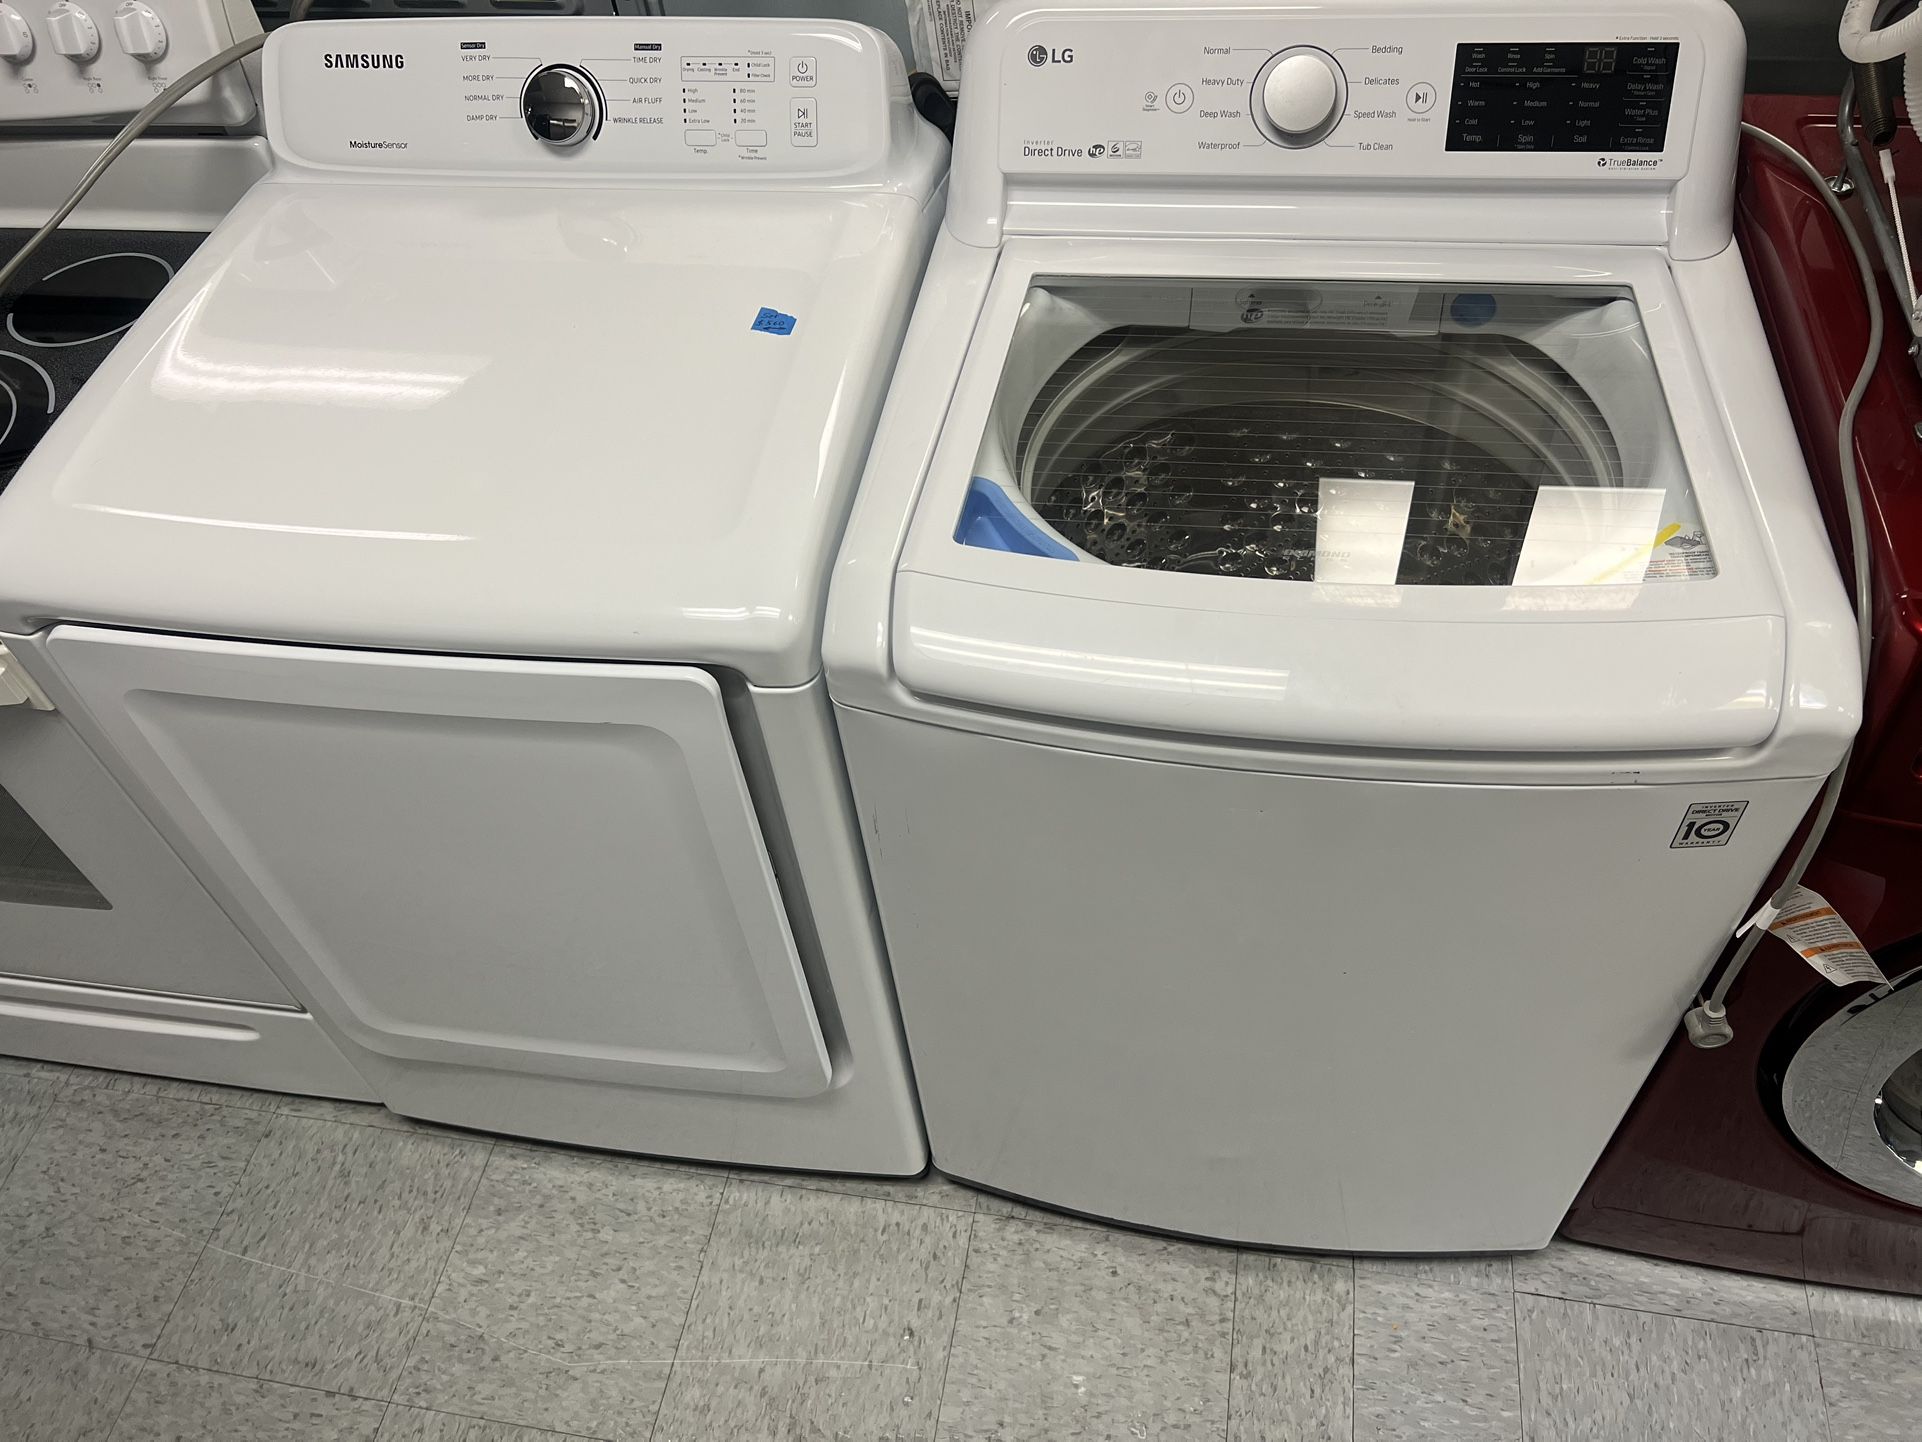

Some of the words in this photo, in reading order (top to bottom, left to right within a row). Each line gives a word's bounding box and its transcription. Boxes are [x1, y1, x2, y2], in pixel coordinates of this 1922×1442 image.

[1203, 46, 1231, 55] Normal
[1371, 45, 1403, 55] Bedding
[1051, 48, 1074, 64] LG
[1632, 56, 1647, 64] Cold
[324, 53, 405, 69] SAMSUNG
[1201, 78, 1225, 88] Heavy
[1226, 78, 1245, 88] Duty
[1364, 77, 1400, 85] Delicates
[1526, 81, 1540, 89] High
[1627, 83, 1645, 91] Delay
[1200, 110, 1218, 119] Deep
[1219, 110, 1241, 118] Wash
[1354, 110, 1376, 120] Speed
[1376, 110, 1397, 118] Wash
[1624, 108, 1644, 116] Water
[1645, 108, 1659, 116] Plus
[1576, 119, 1591, 128] Light
[1518, 134, 1534, 143] Spin
[1573, 135, 1587, 143] Soil
[1619, 136, 1637, 144] Extra
[349, 140, 408, 149] MoistureSensor
[1198, 141, 1240, 151] Waterproof
[1358, 142, 1372, 150] Tub
[1373, 142, 1394, 150] Clean
[1023, 146, 1054, 157] Direct
[1056, 146, 1083, 157] Drive
[1681, 819, 1730, 841] 10
